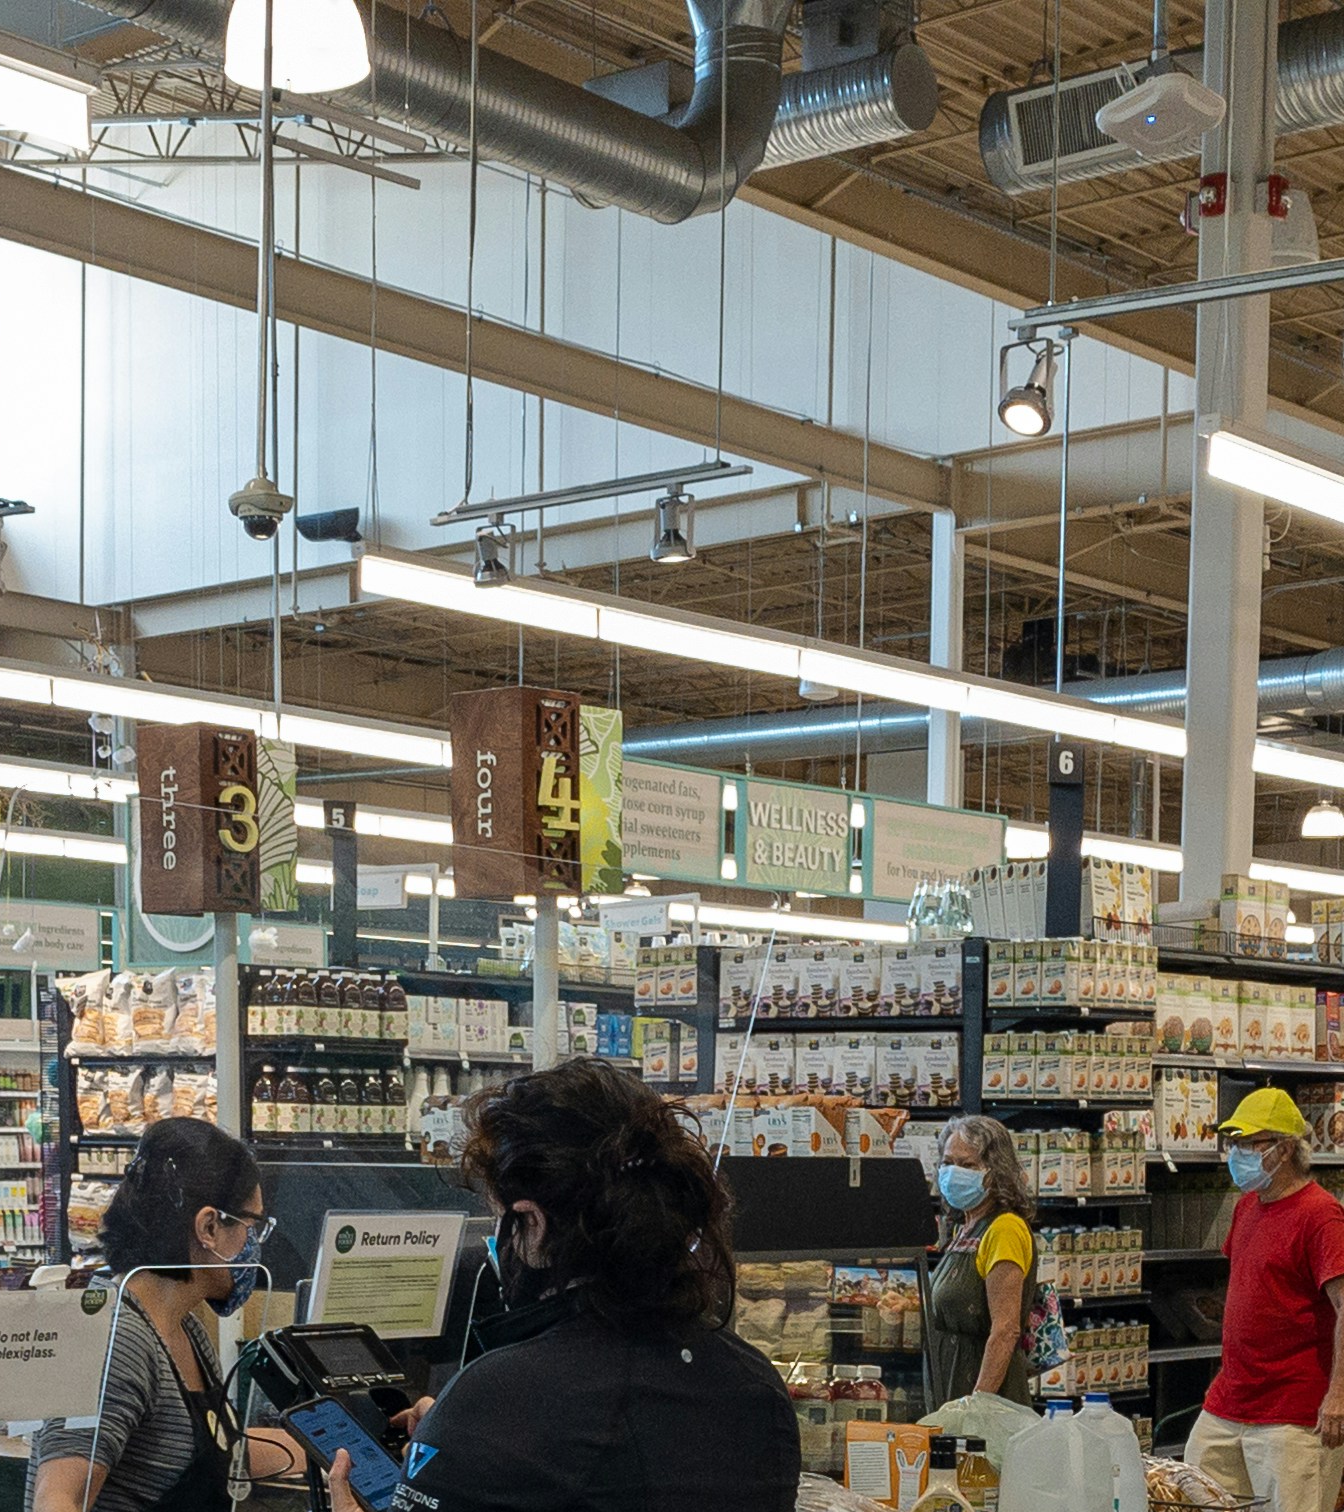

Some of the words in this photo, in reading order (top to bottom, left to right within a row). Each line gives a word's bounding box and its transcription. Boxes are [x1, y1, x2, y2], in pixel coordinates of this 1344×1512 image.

[1059, 751, 1073, 775] 6
[477, 750, 496, 838] four
[538, 756, 581, 831] 4
[678, 780, 701, 800] fats,
[161, 766, 179, 870] three
[218, 785, 260, 853] 3
[332, 808, 345, 827] 5
[648, 802, 673, 816] corn
[675, 807, 706, 824] syrup
[749, 800, 849, 838] WELLNESS
[640, 823, 702, 843] sweeteners
[755, 838, 770, 866] &
[772, 841, 845, 872] BEAUTY
[361, 1231, 401, 1247] Return
[404, 1230, 440, 1248] Policy
[11, 1330, 30, 1343] not
[33, 1329, 58, 1342] lean
